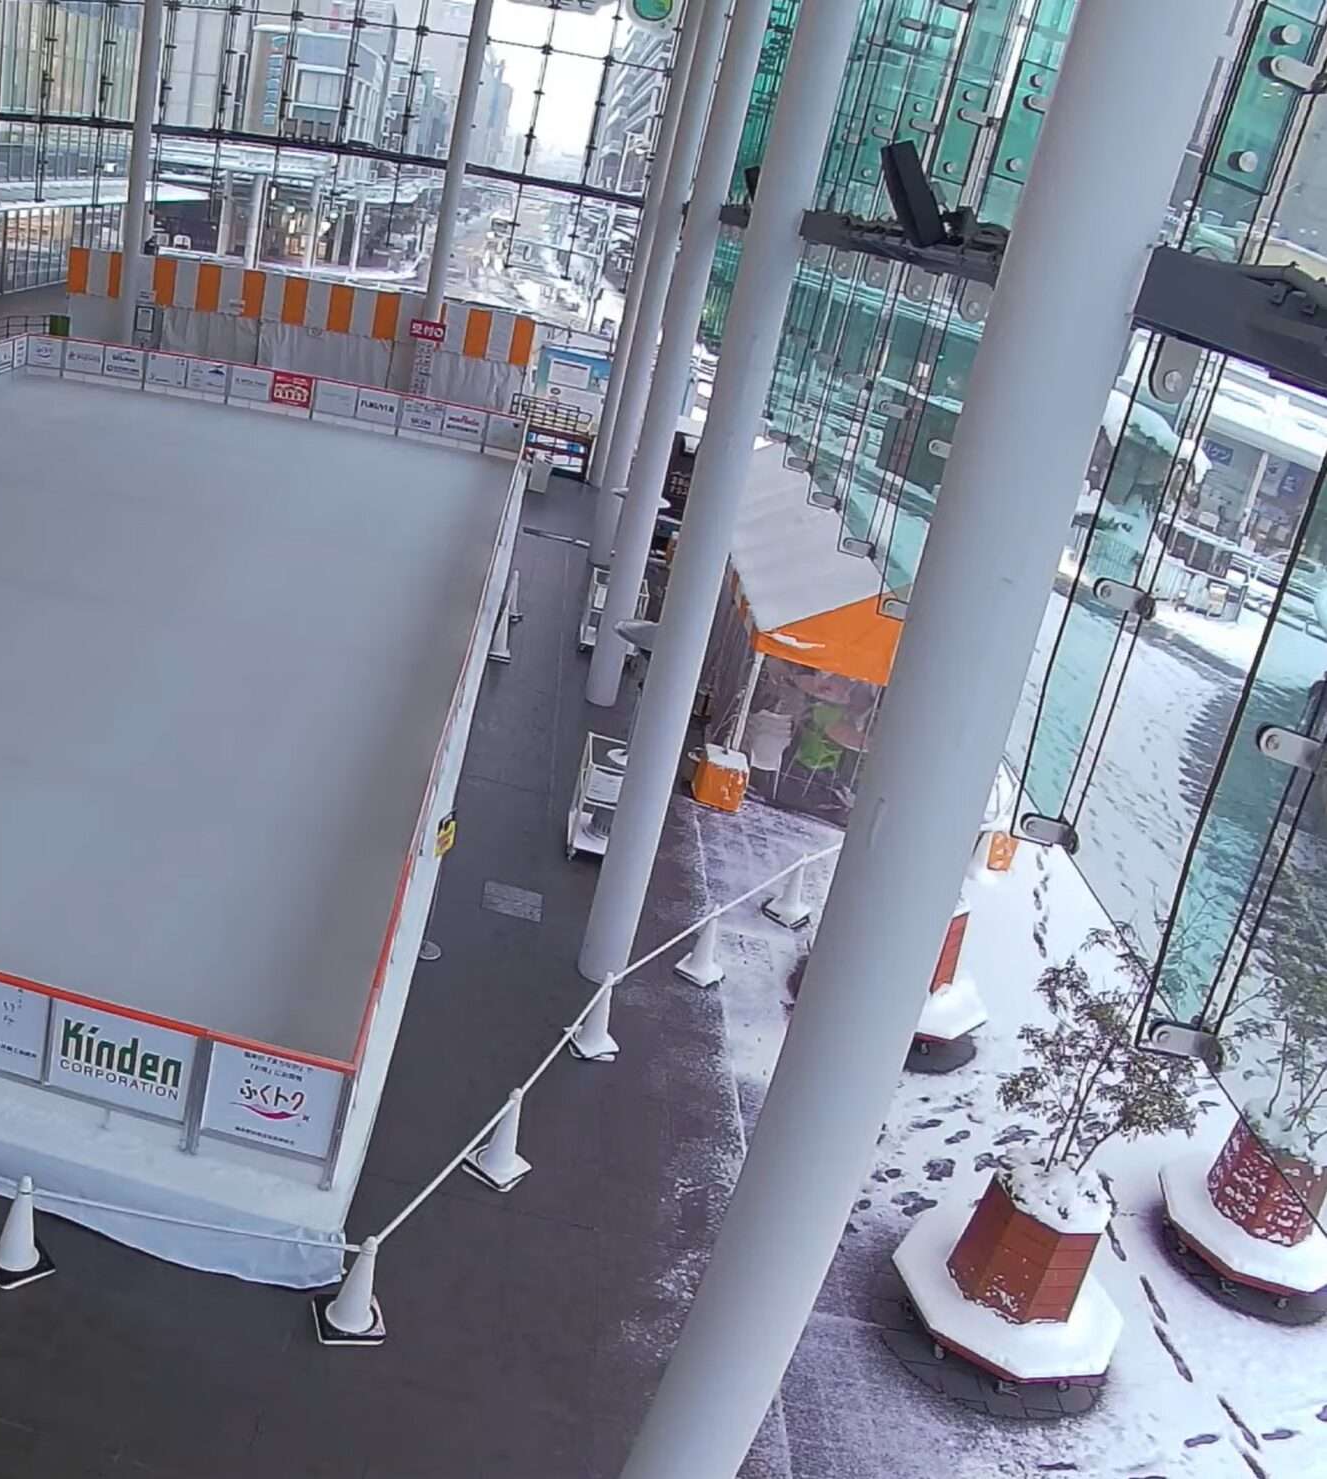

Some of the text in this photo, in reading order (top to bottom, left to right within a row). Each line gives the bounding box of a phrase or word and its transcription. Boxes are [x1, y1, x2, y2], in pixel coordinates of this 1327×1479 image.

[60, 1017, 182, 1089] Kinden
[59, 1059, 180, 1101] CORPORATION
[240, 1078, 305, 1112] ふくトク
